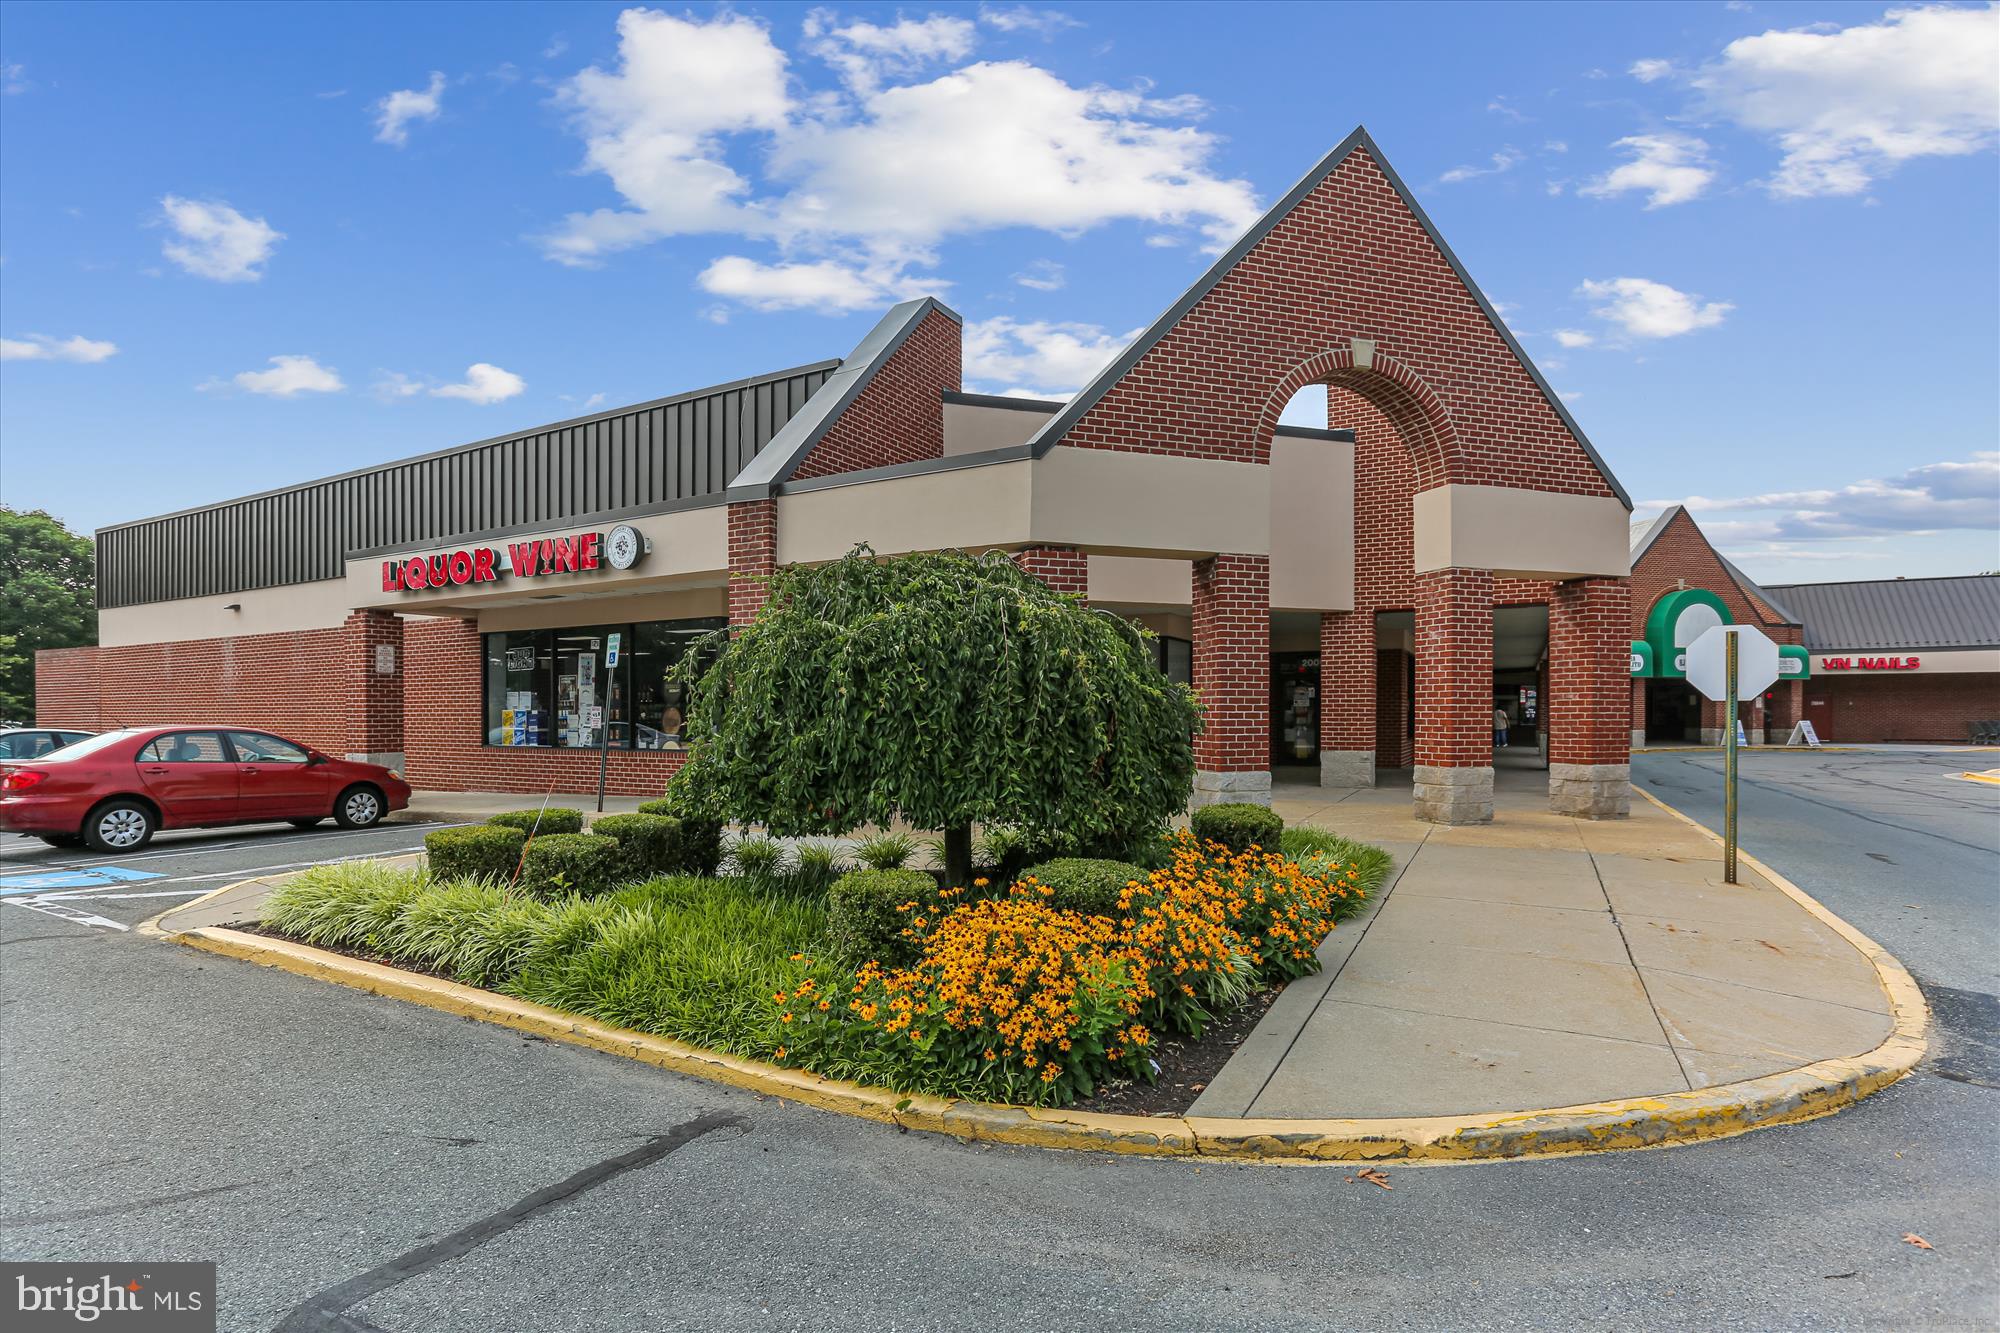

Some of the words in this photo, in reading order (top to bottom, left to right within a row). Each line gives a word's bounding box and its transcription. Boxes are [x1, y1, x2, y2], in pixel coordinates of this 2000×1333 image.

[382, 547, 497, 593] LIQUOR
[508, 532, 600, 578] WINE
[1822, 657, 1851, 671] VN
[1858, 656, 1920, 670] NAILS
